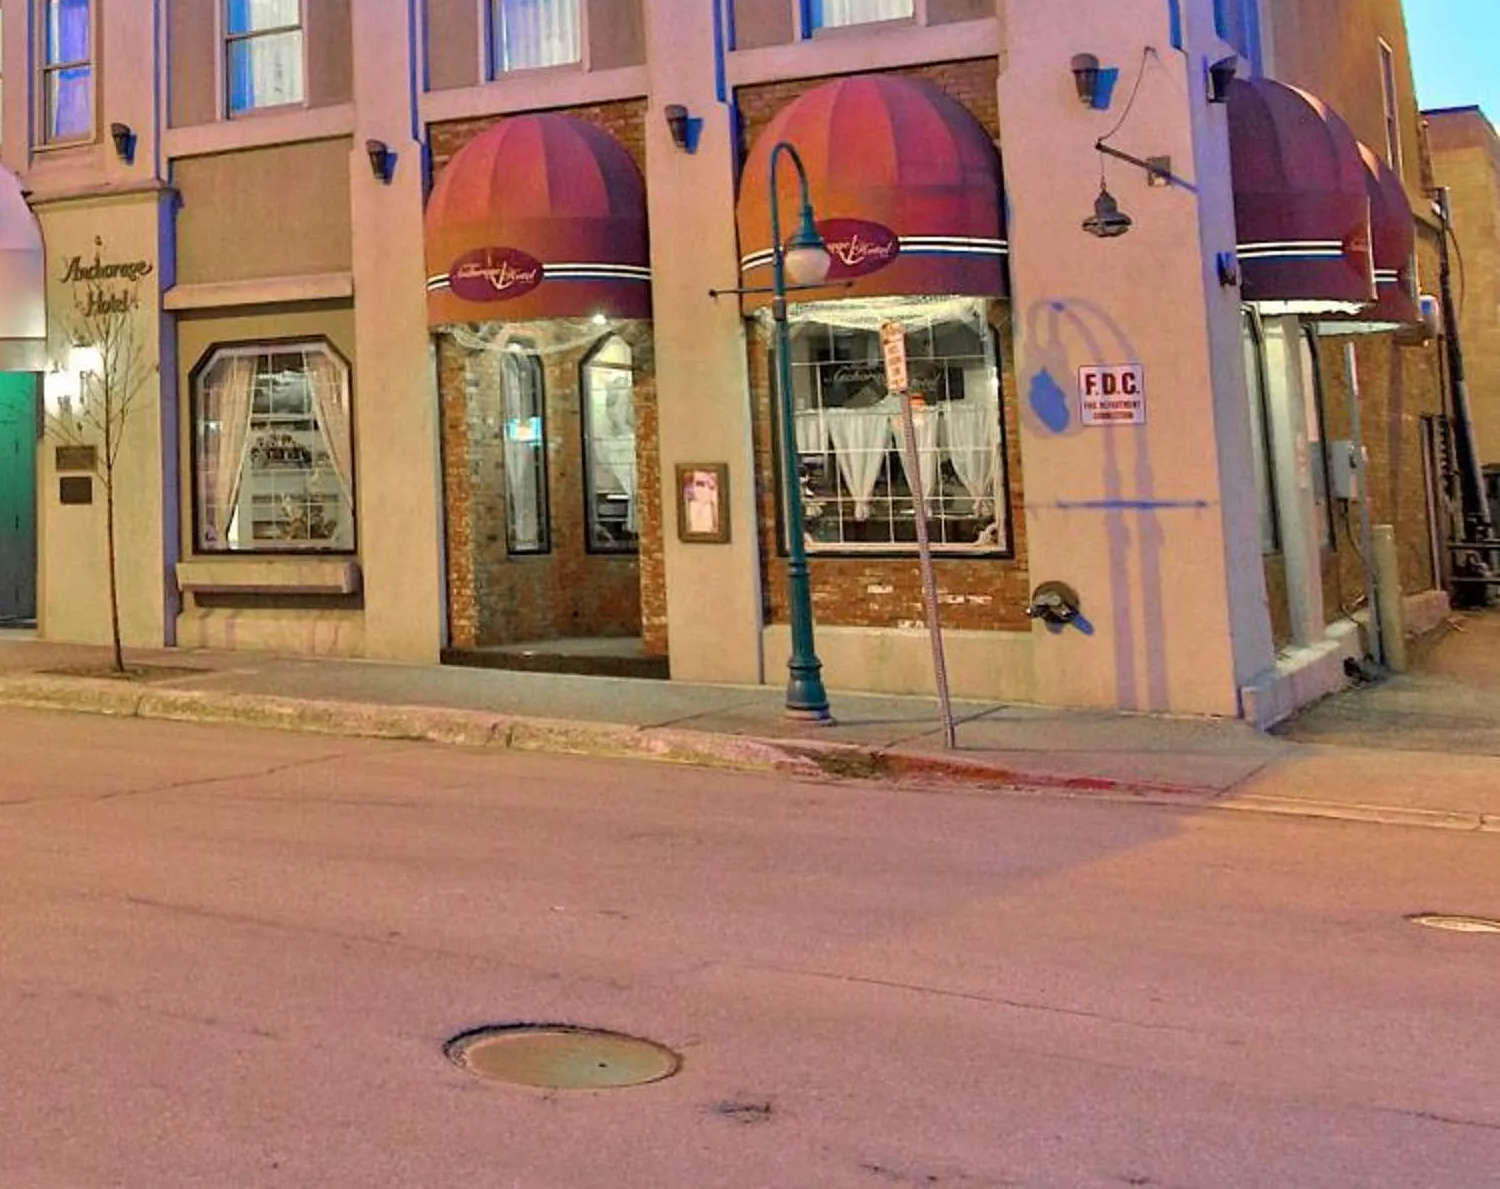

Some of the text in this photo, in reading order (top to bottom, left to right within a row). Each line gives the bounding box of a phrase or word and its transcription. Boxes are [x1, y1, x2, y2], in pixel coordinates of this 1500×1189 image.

[60, 255, 153, 283] Anchorage
[85, 290, 129, 317] Hotel
[1085, 372, 1140, 396] F.D.C.
